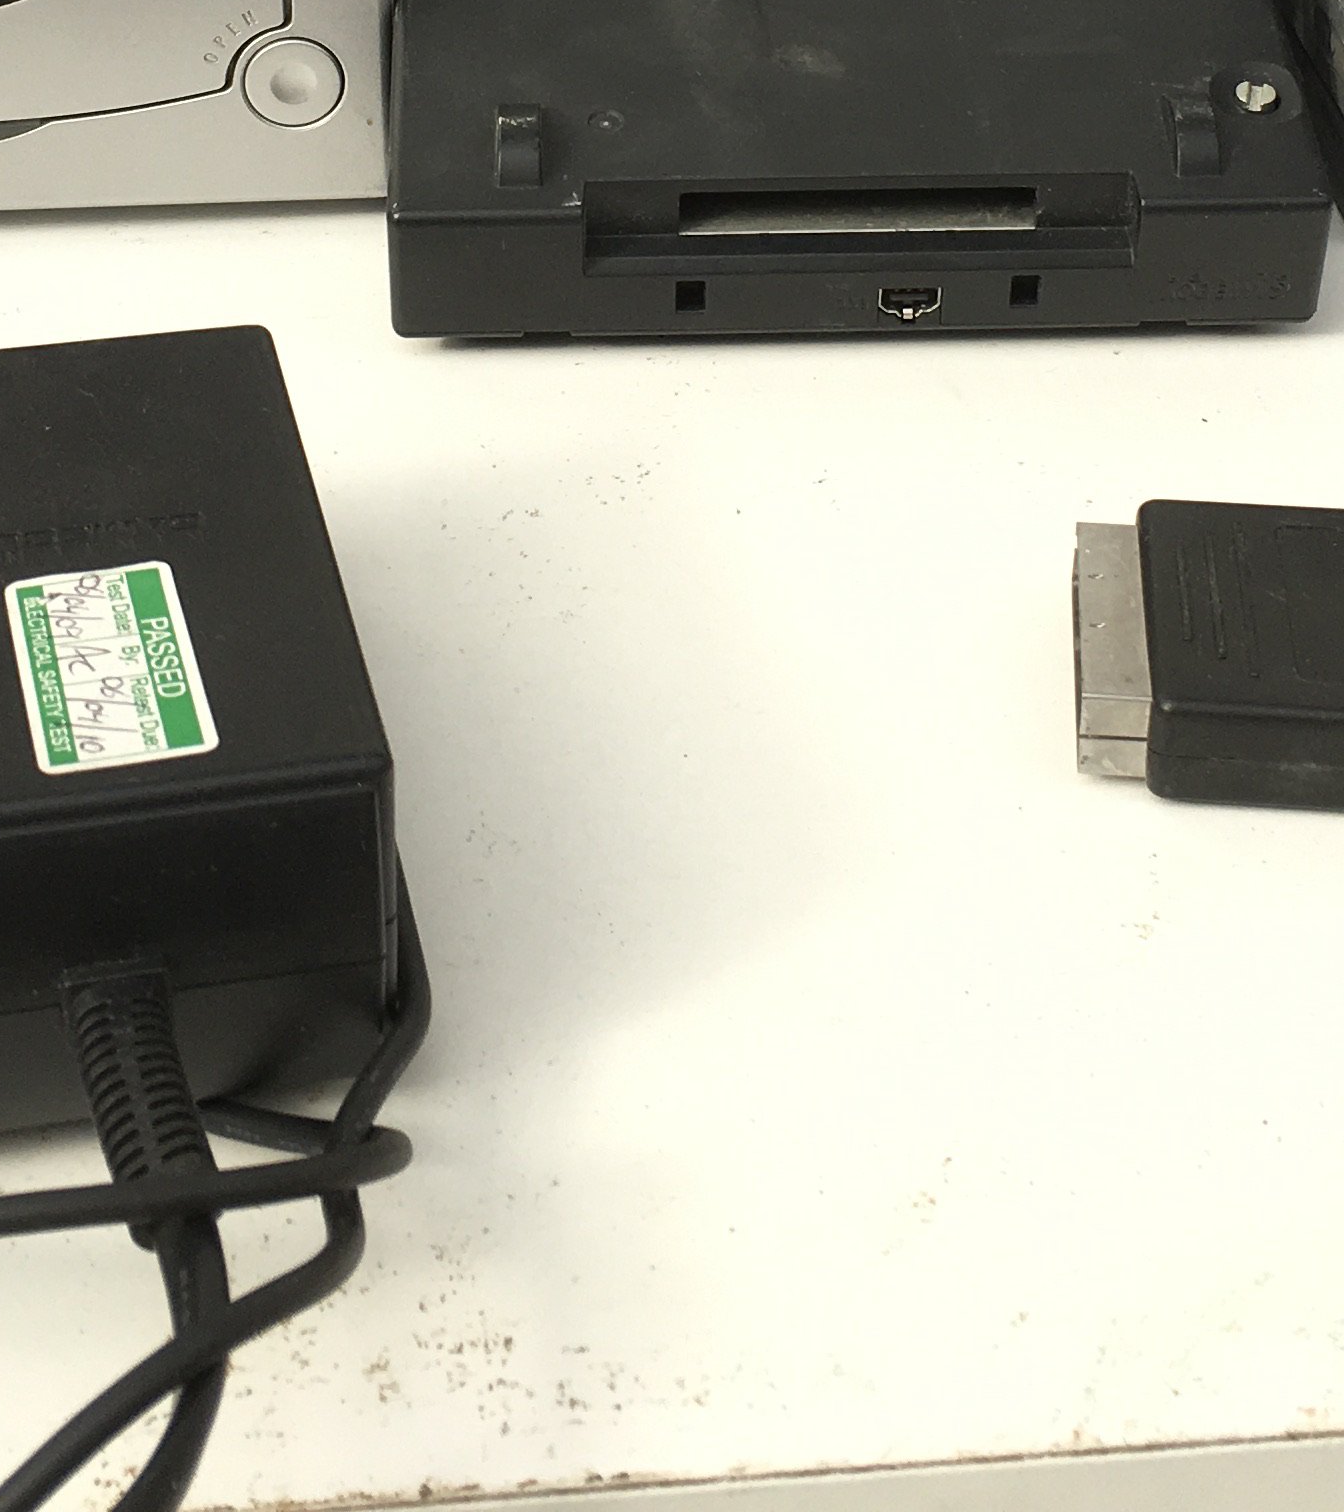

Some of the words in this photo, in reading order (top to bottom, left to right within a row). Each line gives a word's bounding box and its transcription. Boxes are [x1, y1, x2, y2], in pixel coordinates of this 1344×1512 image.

[202, 9, 259, 64] OPEN
[105, 574, 126, 602] Test
[23, 595, 53, 669] ELECTRICAL
[140, 615, 187, 699] PASSED
[37, 669, 63, 717] SAFETY
[129, 676, 155, 719] Retest
